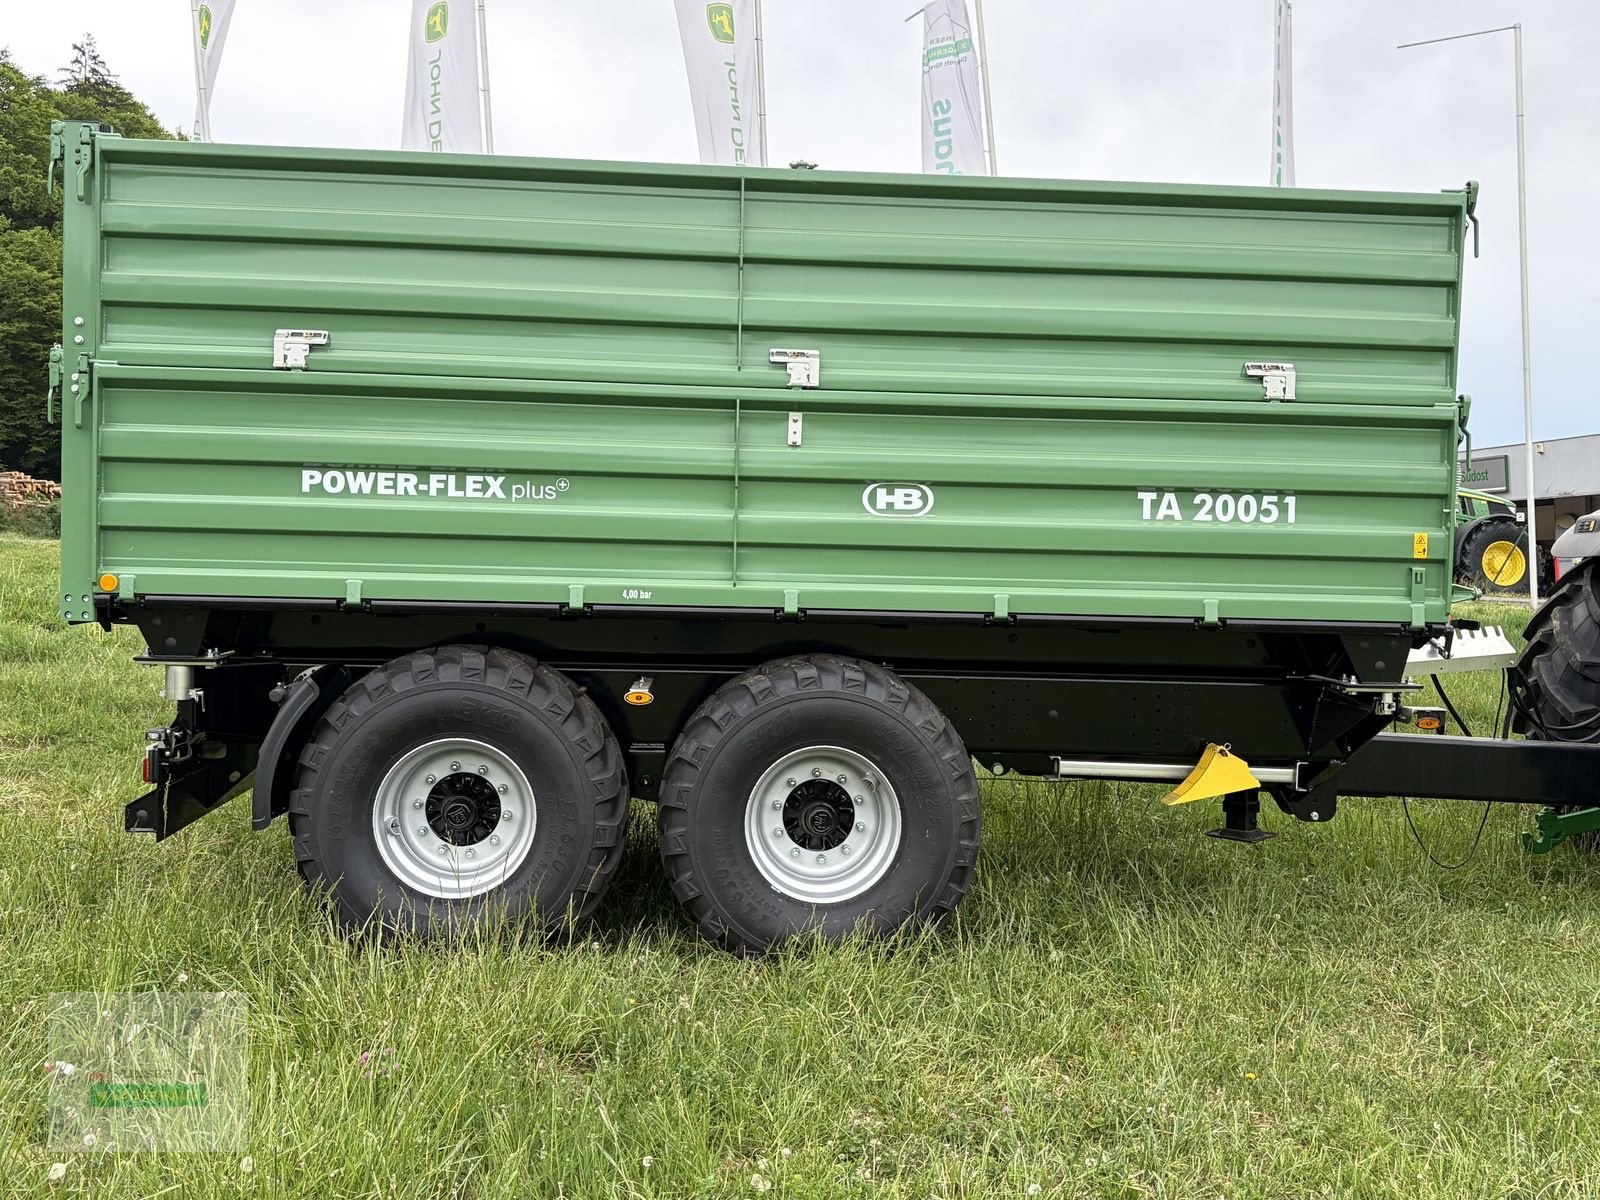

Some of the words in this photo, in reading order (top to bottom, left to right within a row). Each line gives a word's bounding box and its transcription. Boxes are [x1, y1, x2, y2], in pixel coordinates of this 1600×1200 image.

[301, 470, 506, 499] POWER-FLEX
[876, 488, 923, 510] HB
[1137, 491, 1183, 521] TA
[1192, 493, 1296, 524] 20051
[622, 589, 638, 600] 4,00
[640, 589, 652, 599] bar
